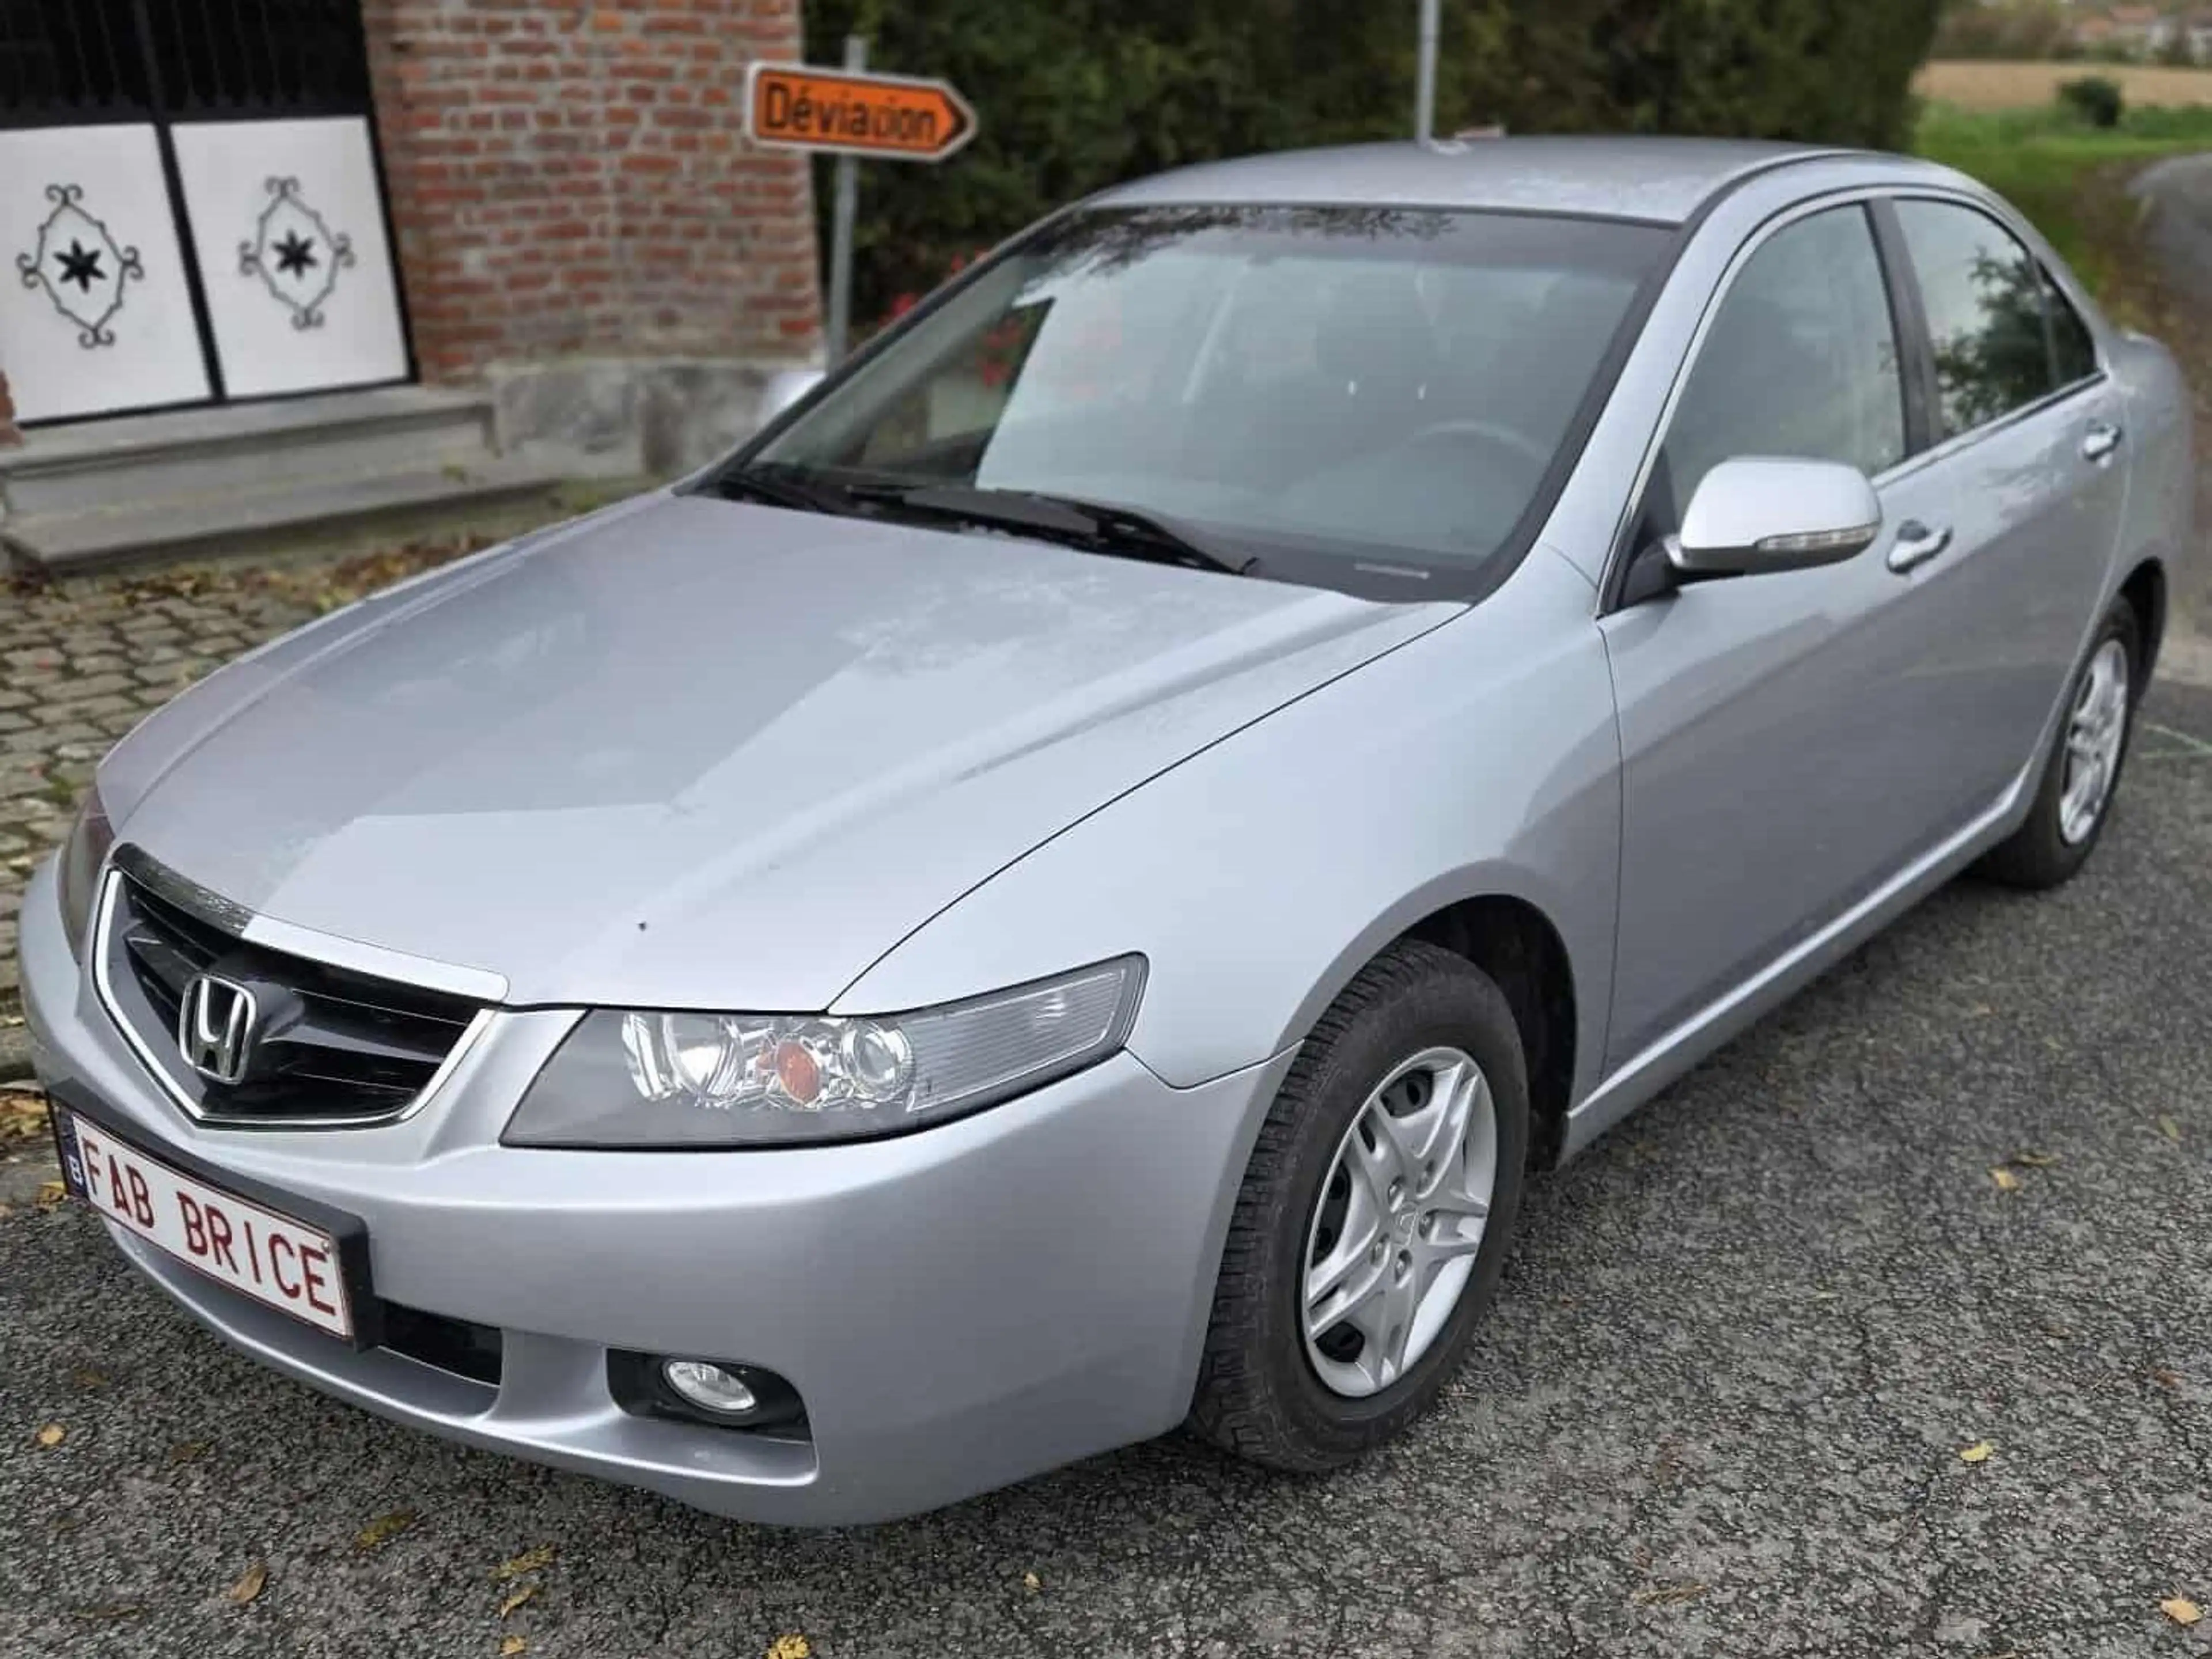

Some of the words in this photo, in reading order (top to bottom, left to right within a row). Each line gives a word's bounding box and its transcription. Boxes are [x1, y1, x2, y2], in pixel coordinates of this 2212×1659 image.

[67, 1154, 84, 1185] B
[82, 1138, 154, 1228] FAB
[176, 1191, 336, 1316] BRICE
